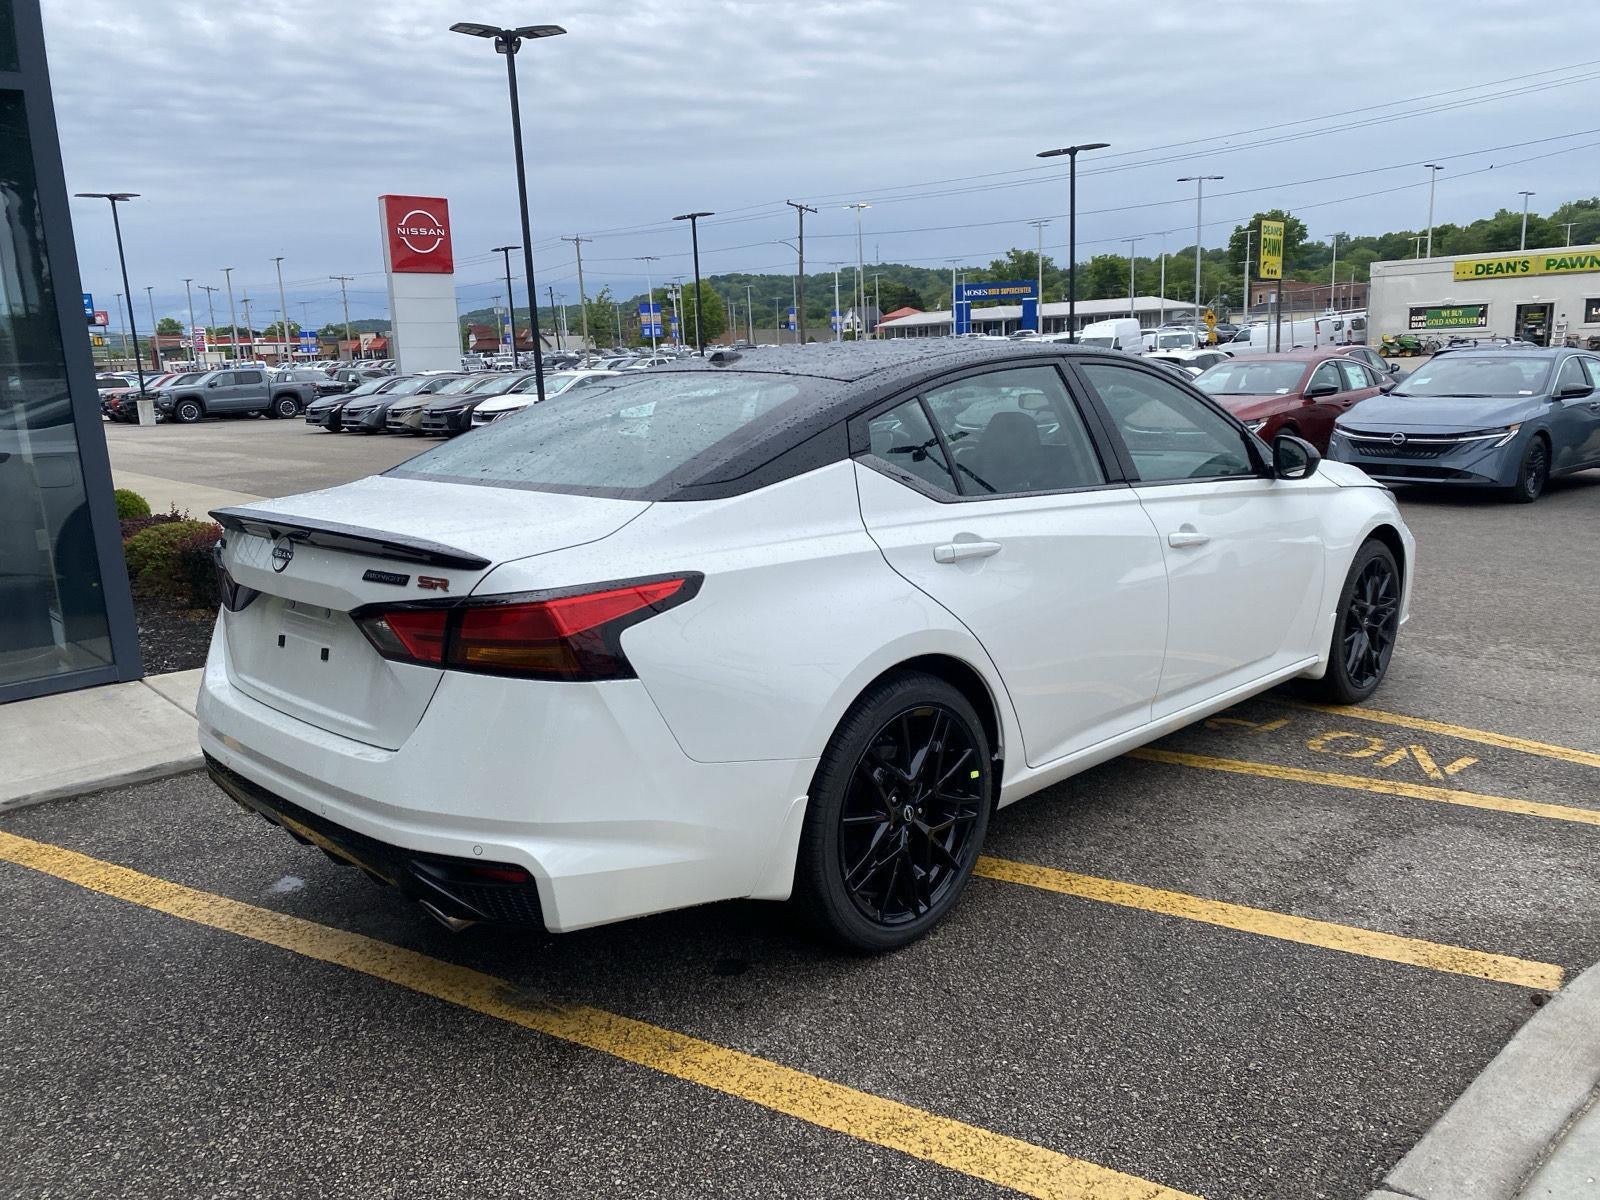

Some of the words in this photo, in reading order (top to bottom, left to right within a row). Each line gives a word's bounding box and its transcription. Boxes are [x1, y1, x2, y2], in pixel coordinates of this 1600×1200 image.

[397, 227, 445, 236] NISSAN
[1263, 225, 1282, 236] DEAN'S
[1263, 238, 1281, 257] PAWN
[1474, 260, 1530, 275] DEAN'S
[1545, 255, 1600, 271] PAWN
[1001, 286, 1031, 294] SUPERCENTER
[1459, 317, 1477, 325] SILVER
[417, 575, 450, 593] SR
